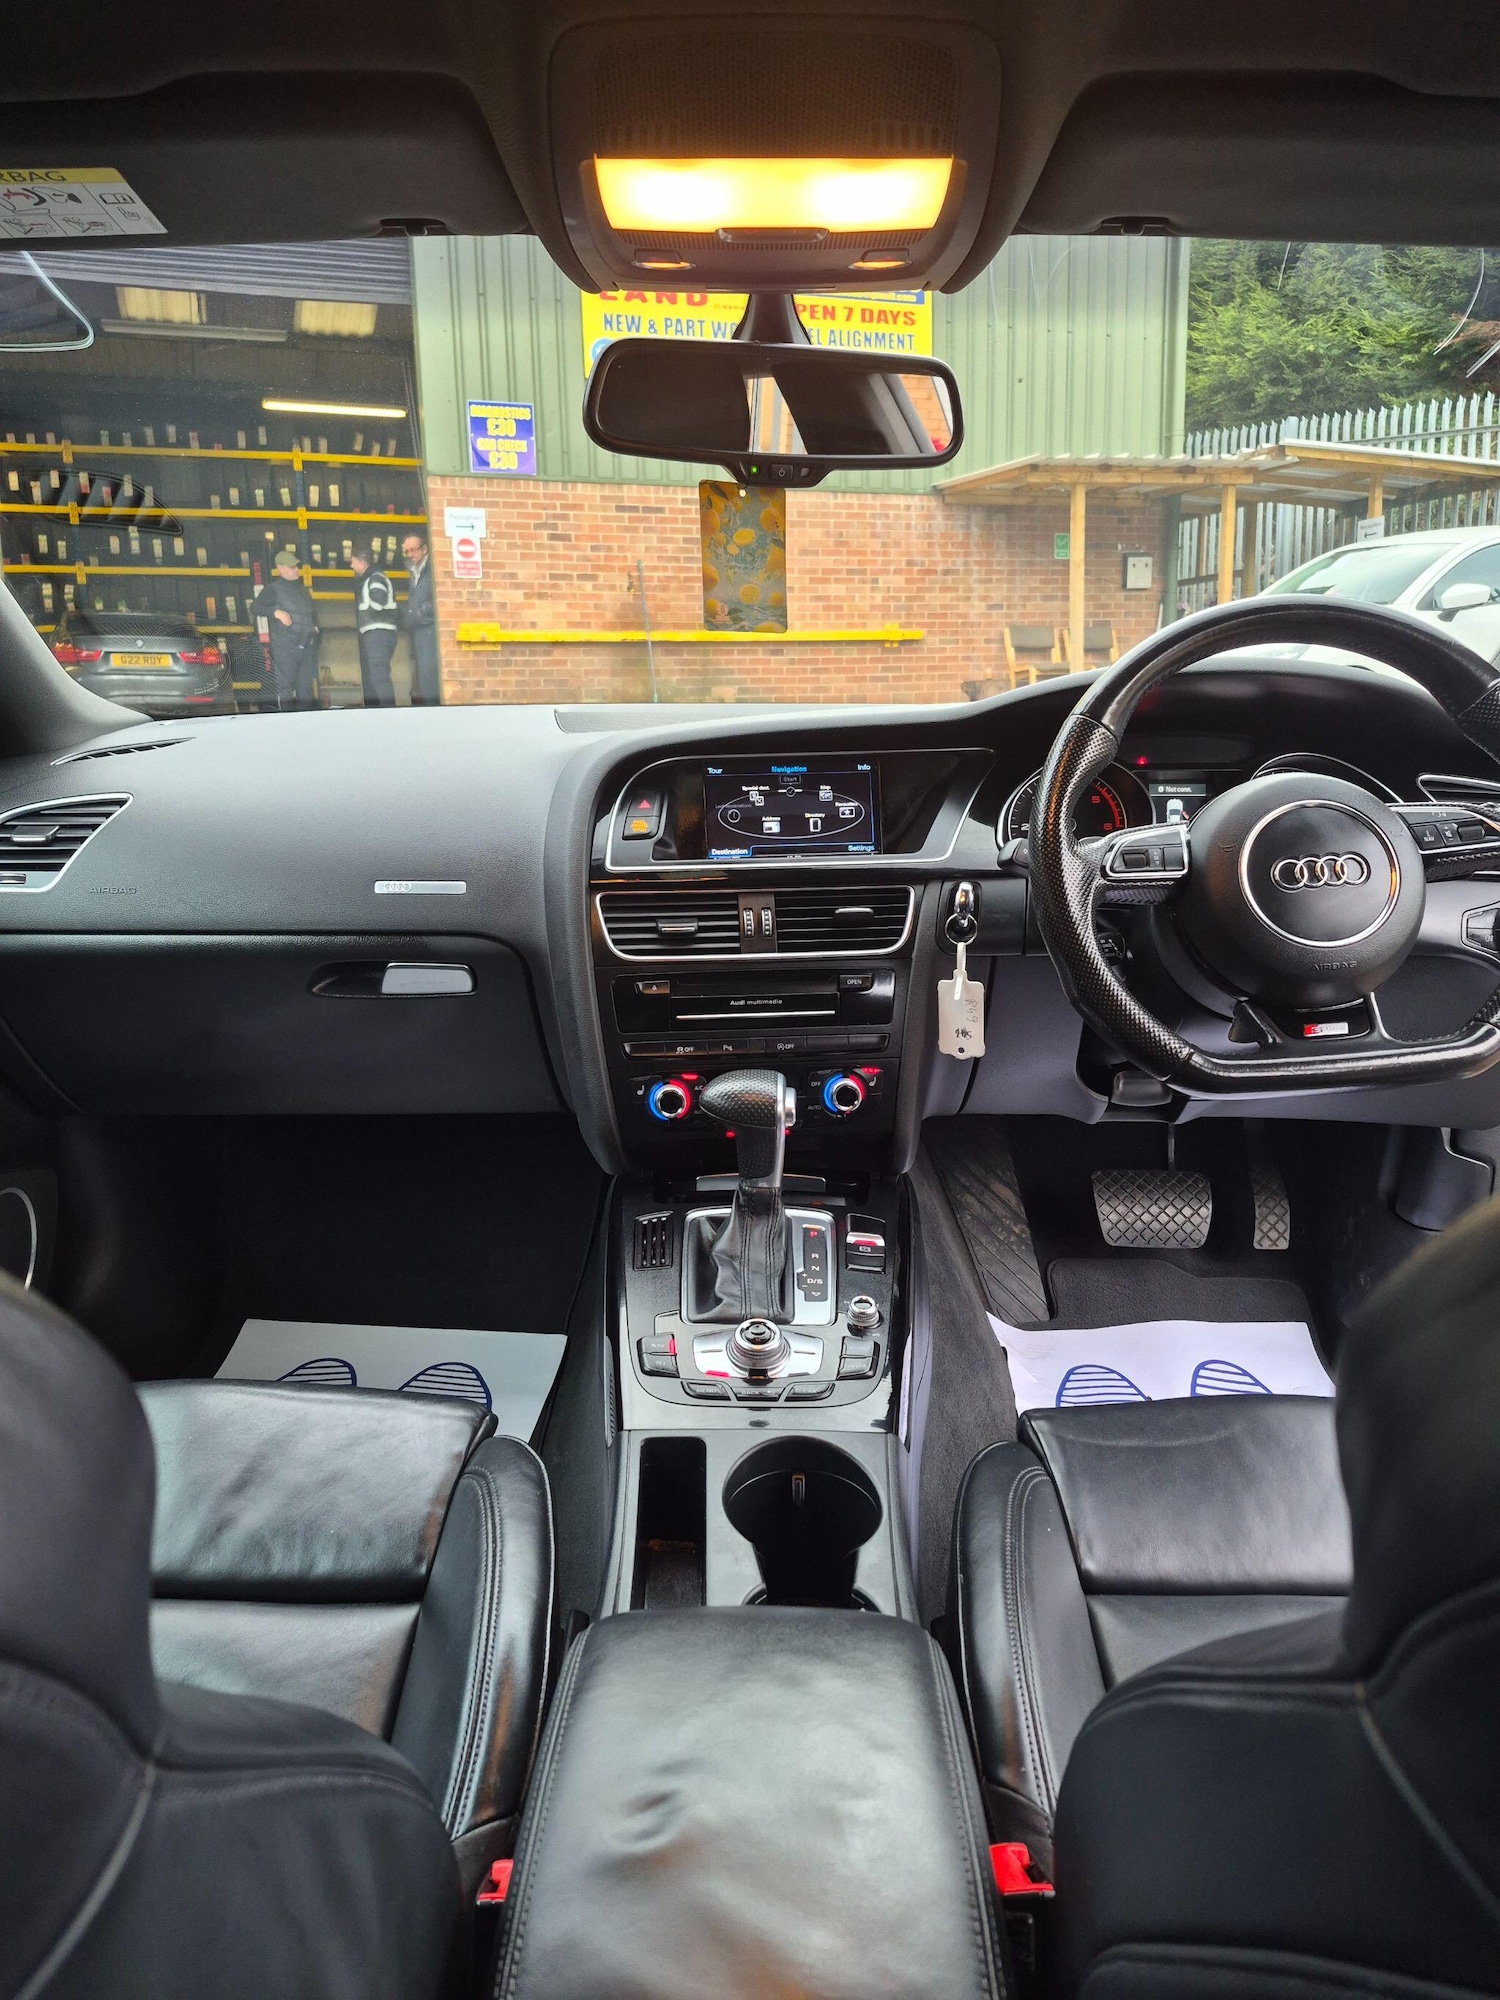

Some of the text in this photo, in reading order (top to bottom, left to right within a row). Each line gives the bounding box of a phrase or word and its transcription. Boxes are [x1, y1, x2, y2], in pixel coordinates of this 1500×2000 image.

[843, 307, 853, 321] 7
[861, 308, 916, 326] DAYS
[604, 313, 641, 334] NEW
[648, 319, 658, 335] &
[664, 318, 705, 337] PART
[828, 328, 915, 351] ALIGNMENT
[121, 655, 140, 665] G22
[771, 766, 807, 774] Navigation
[1092, 795, 1101, 804] 5
[1021, 823, 1029, 831] 2
[1103, 823, 1113, 831] 6
[89, 886, 137, 894] AIRBAG
[1313, 960, 1358, 971] AIRBAG
[747, 998, 783, 1006] multimedia
